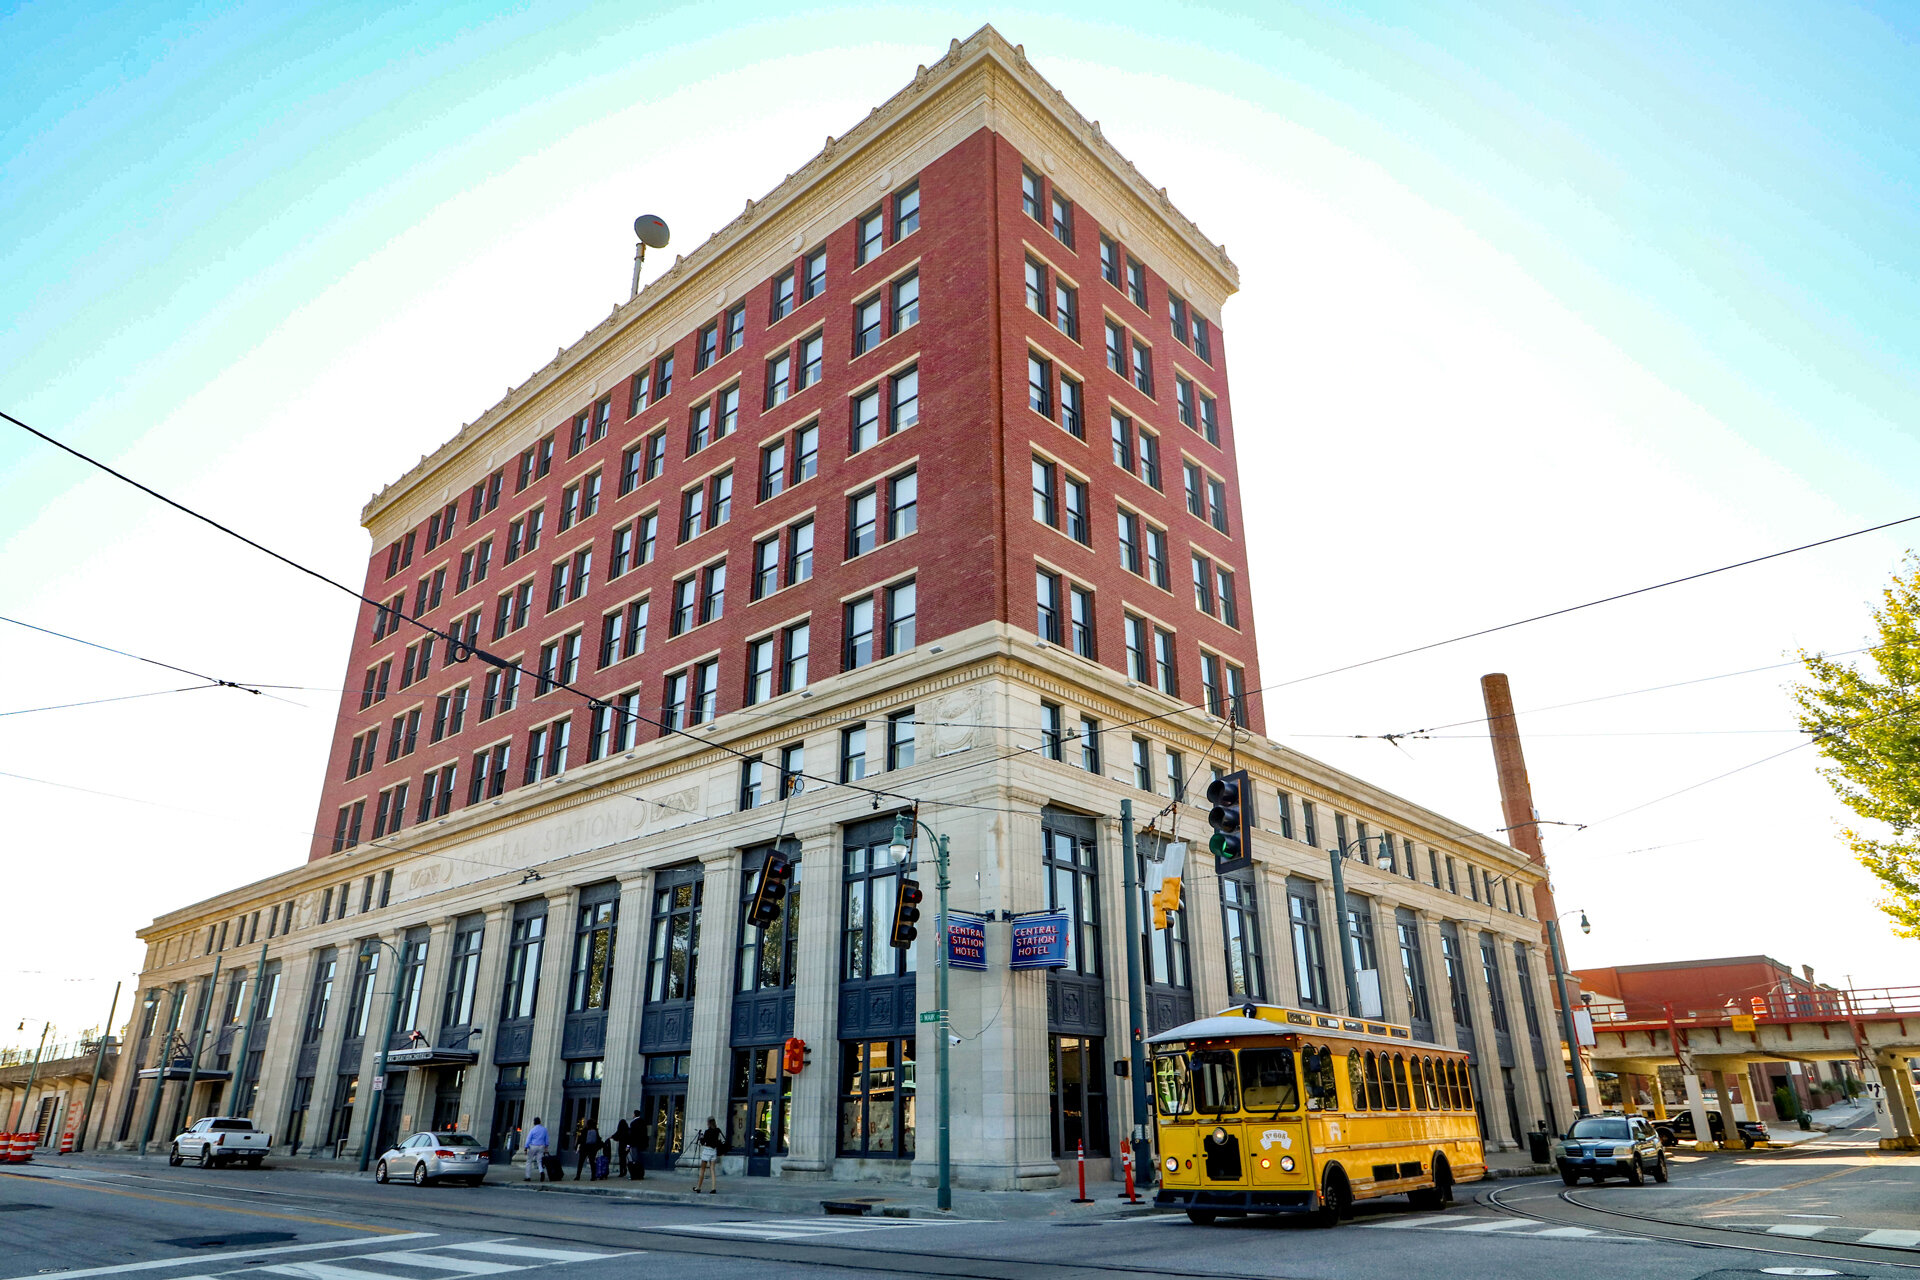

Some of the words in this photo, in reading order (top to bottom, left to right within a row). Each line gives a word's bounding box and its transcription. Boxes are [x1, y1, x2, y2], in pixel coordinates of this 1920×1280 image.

[462, 839, 530, 876] CENTRAL
[543, 812, 618, 853] STATION
[948, 925, 985, 938] CENTRAL
[1014, 925, 1059, 937] CENTRAL
[951, 936, 984, 947] STATION
[1016, 935, 1057, 947] STATION
[954, 946, 981, 958] HOTEL
[1018, 946, 1050, 956] HOTEL
